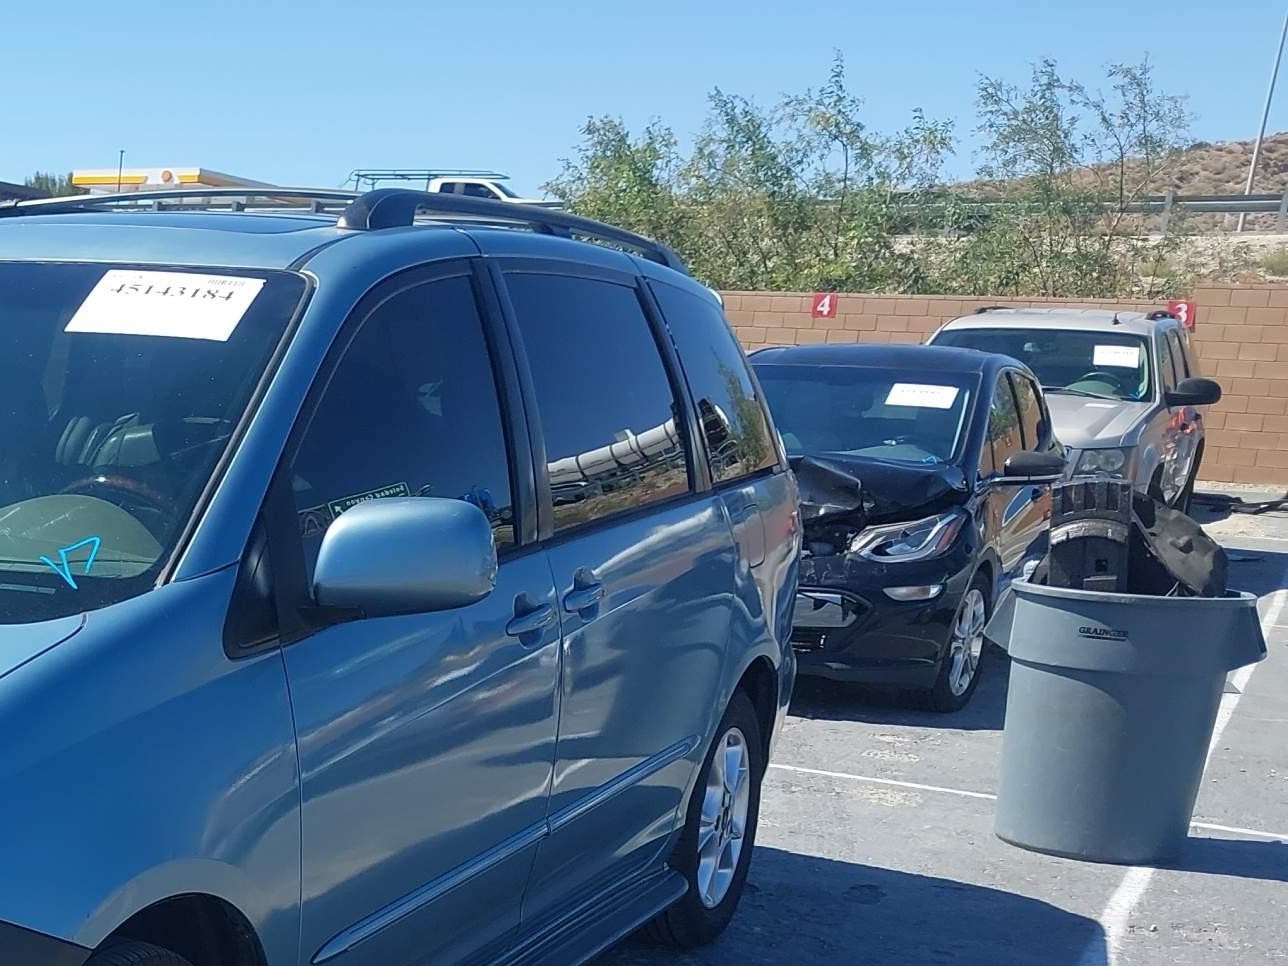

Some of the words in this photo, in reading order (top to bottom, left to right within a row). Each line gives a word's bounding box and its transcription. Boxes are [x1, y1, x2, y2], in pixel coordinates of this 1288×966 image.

[110, 283, 235, 301] 45143184
[816, 295, 831, 316] 4
[1175, 303, 1188, 323] 3
